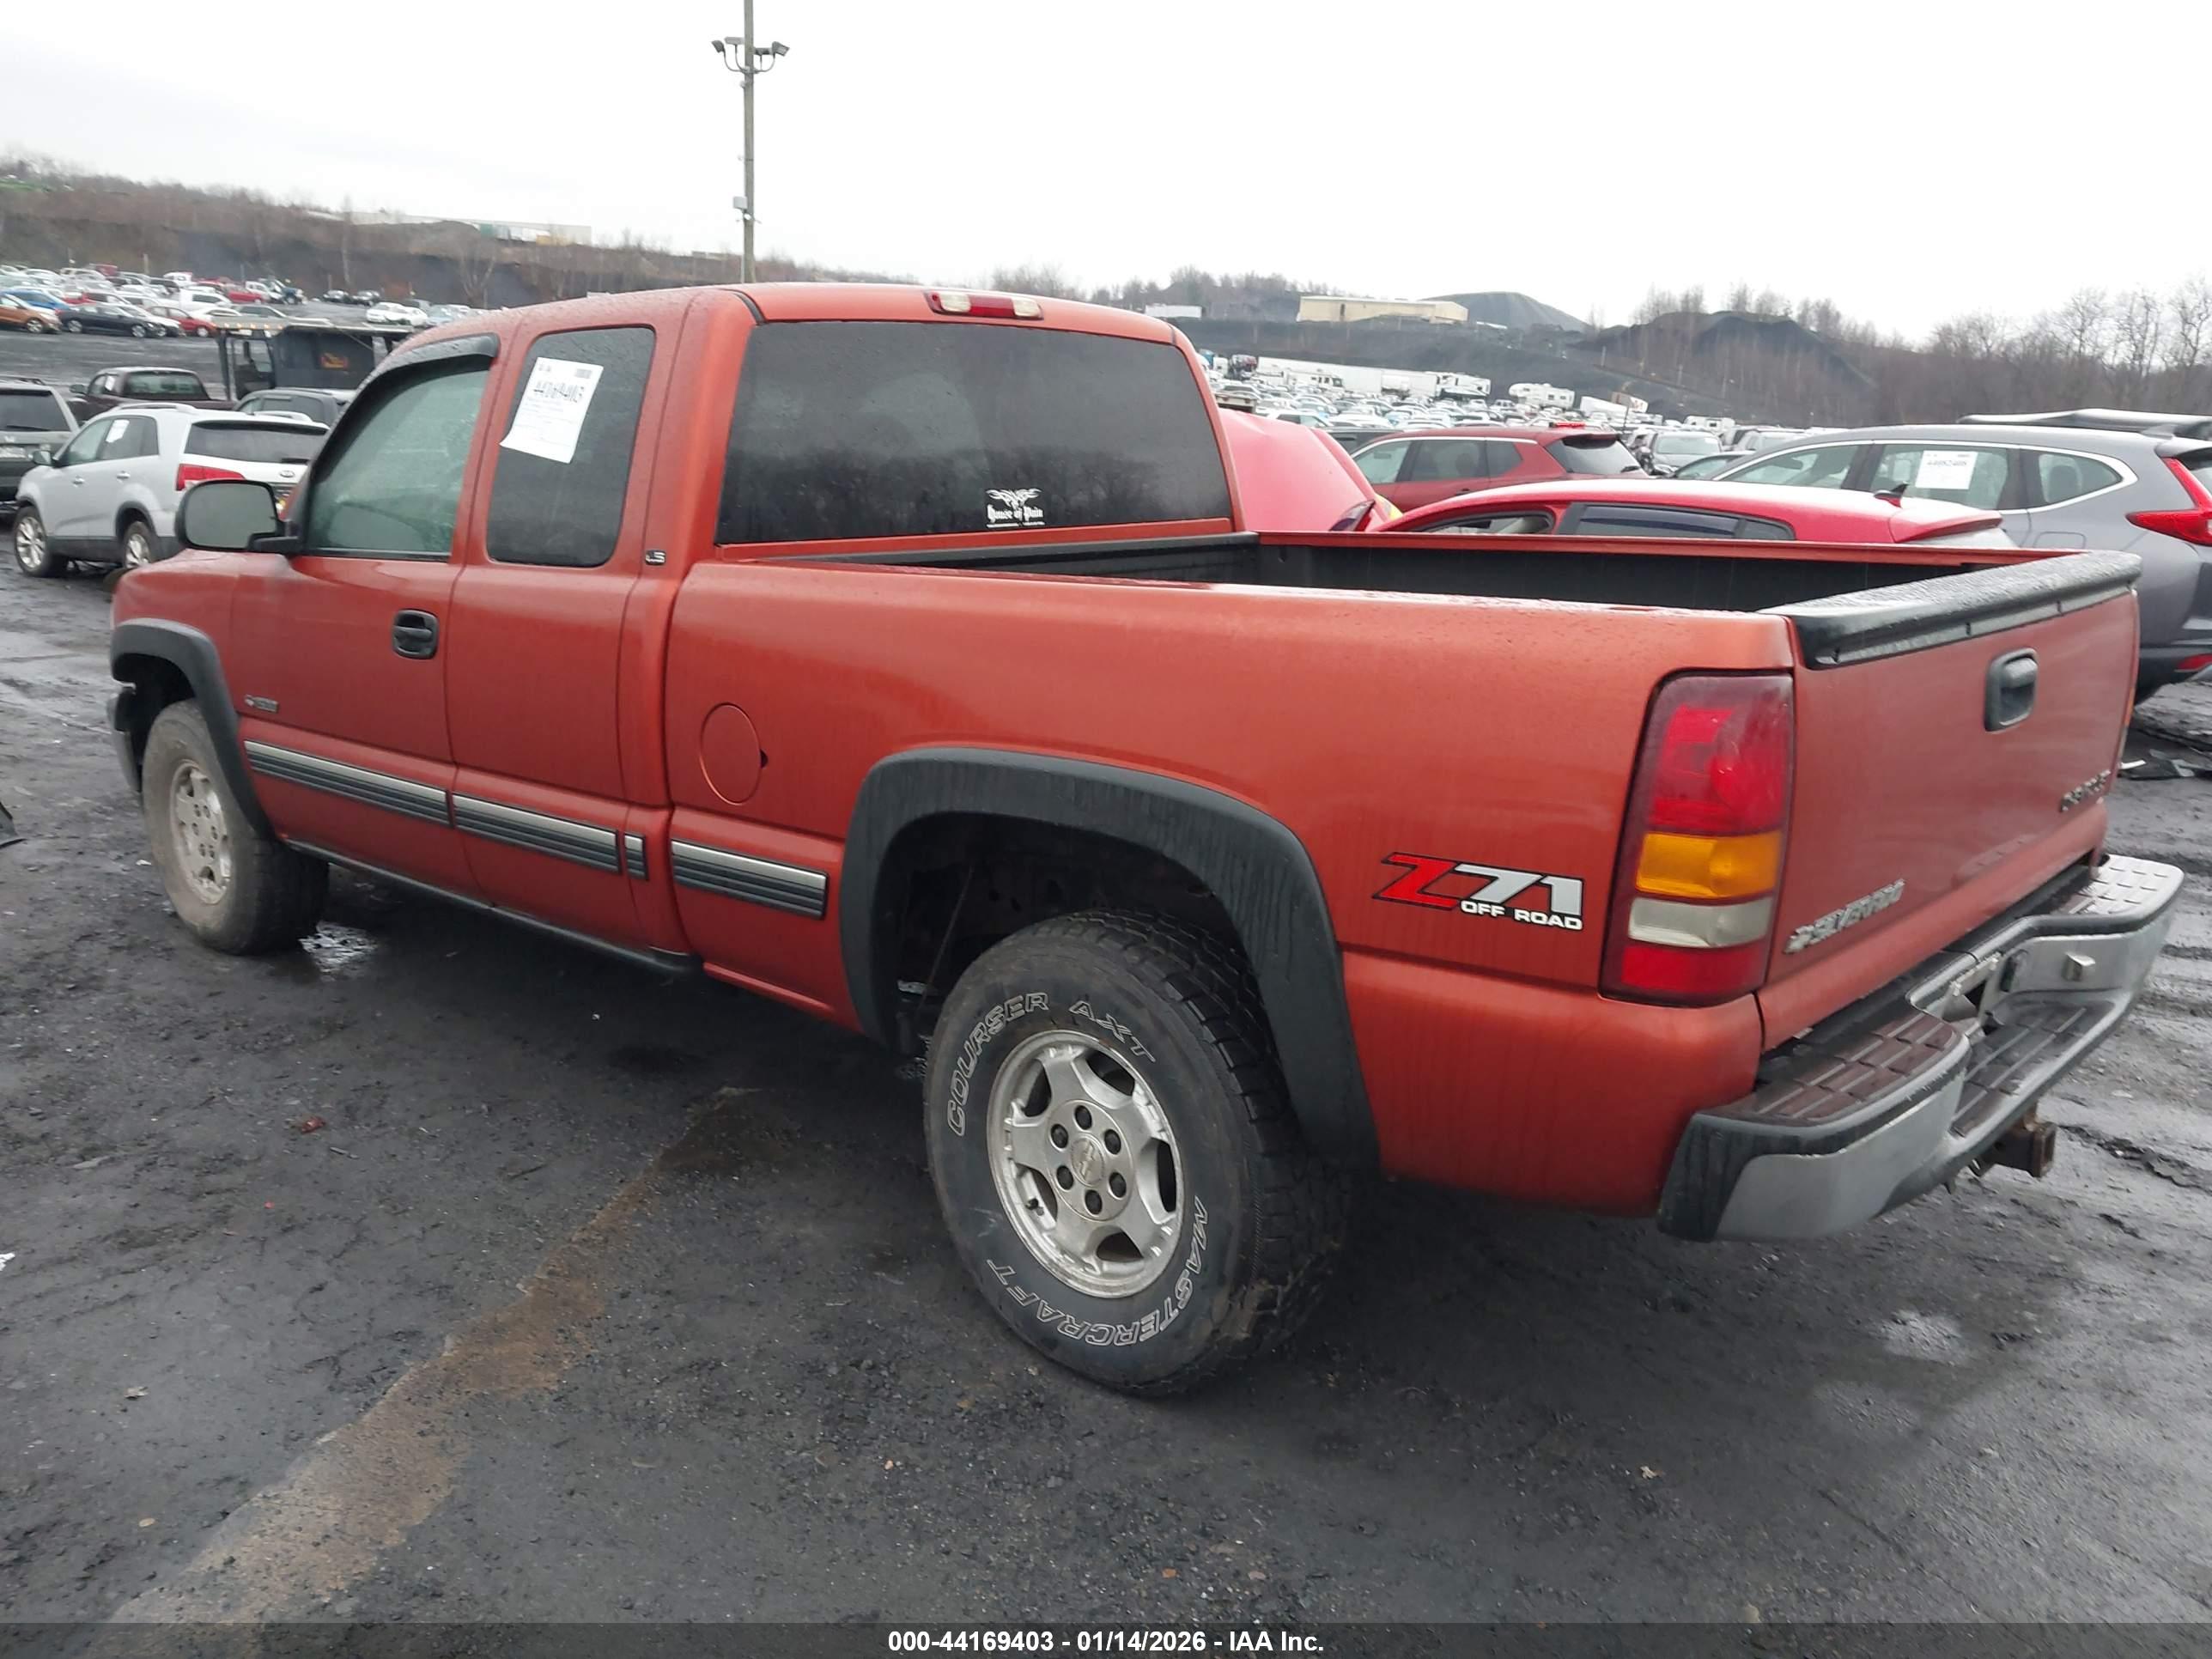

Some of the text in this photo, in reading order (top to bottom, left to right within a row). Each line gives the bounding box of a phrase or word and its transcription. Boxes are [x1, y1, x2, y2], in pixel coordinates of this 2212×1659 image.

[1372, 851, 1584, 917] Z71
[1460, 899, 1583, 931] OFF ROAD
[947, 992, 1156, 1138] COURSER AXT
[987, 1195, 1209, 1346] MASTERCRAFT
